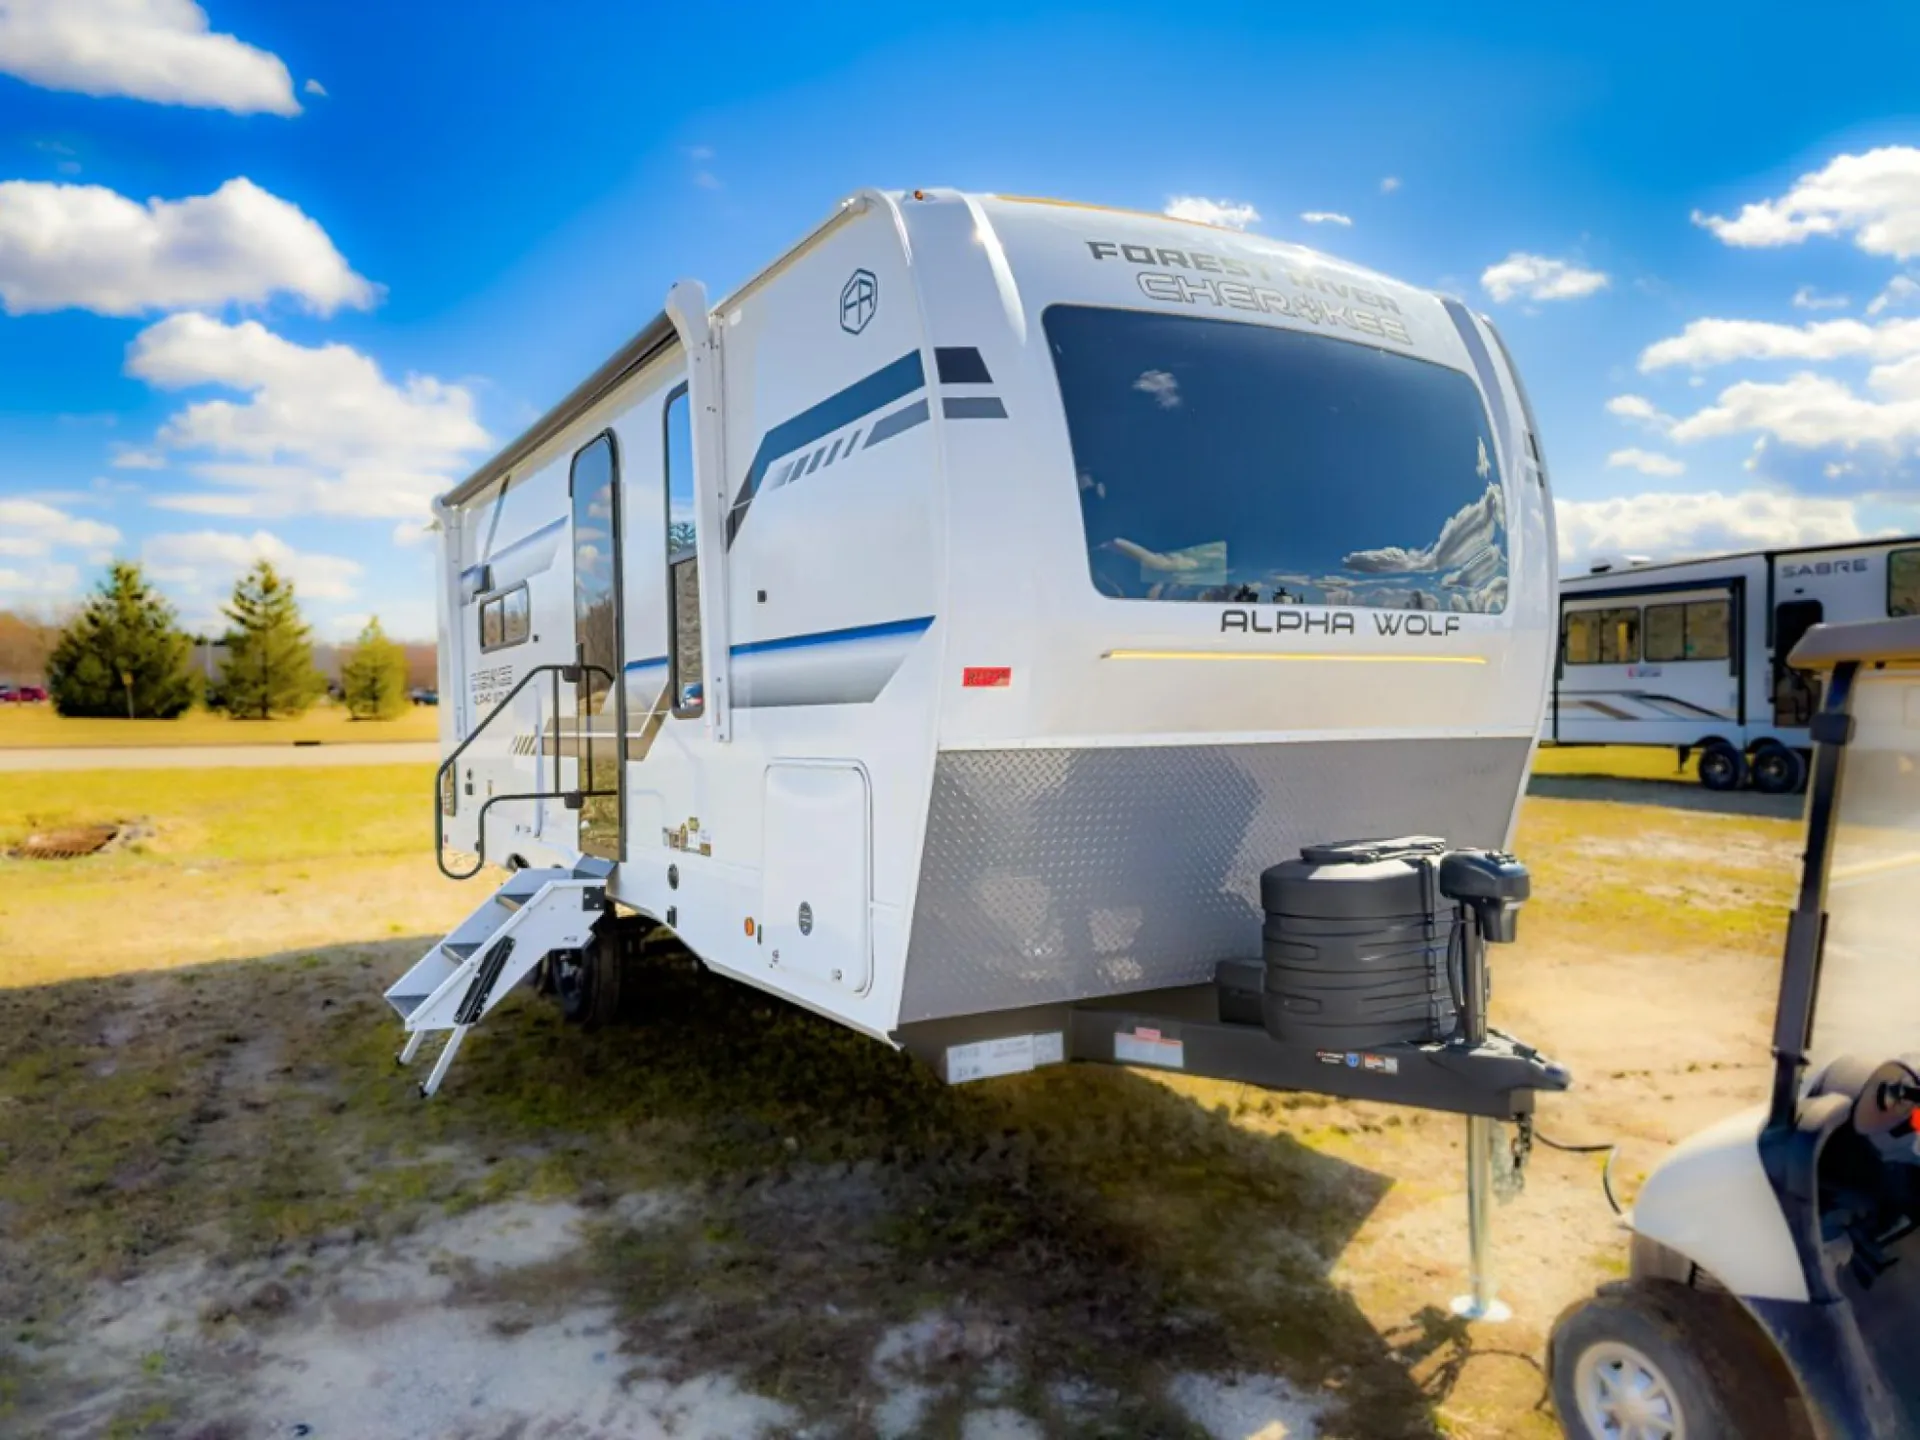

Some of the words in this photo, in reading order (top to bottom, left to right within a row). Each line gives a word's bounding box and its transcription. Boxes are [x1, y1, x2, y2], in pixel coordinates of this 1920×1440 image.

[1086, 240, 1271, 281] FOREST
[1286, 268, 1402, 315] RIVER
[1782, 558, 1869, 579] SABRE
[1220, 609, 1355, 635] ALPHA
[1373, 612, 1461, 637] WOLF
